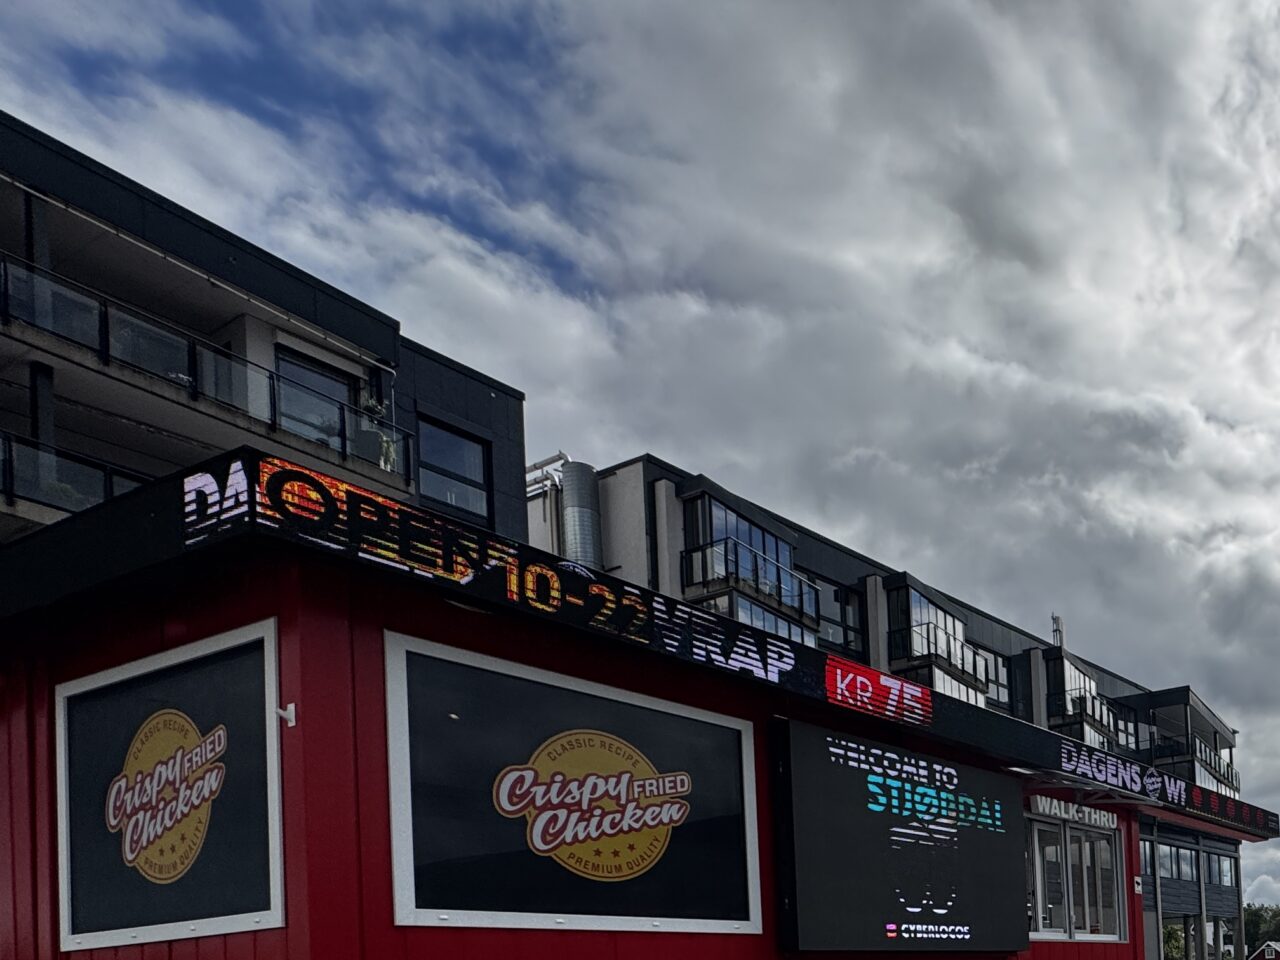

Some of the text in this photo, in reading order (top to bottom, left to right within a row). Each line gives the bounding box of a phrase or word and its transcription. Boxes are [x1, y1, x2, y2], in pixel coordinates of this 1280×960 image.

[837, 668, 924, 724] KR 75
[133, 719, 190, 760] CLASSIC RECIPE
[547, 738, 640, 768] CLASSIC RECIPE
[826, 736, 958, 790] WELCOME TO
[108, 729, 225, 826] Crispy FRIED
[500, 770, 689, 810] Crispy FRIED
[1061, 739, 1142, 792] DAGENS
[125, 768, 222, 860] Chicken
[532, 802, 686, 850] Chicken
[1037, 798, 1118, 830] WALK-THRU
[143, 818, 204, 875] PREMIUM QUALITY
[566, 835, 662, 874] PREMIUM QUALITY
